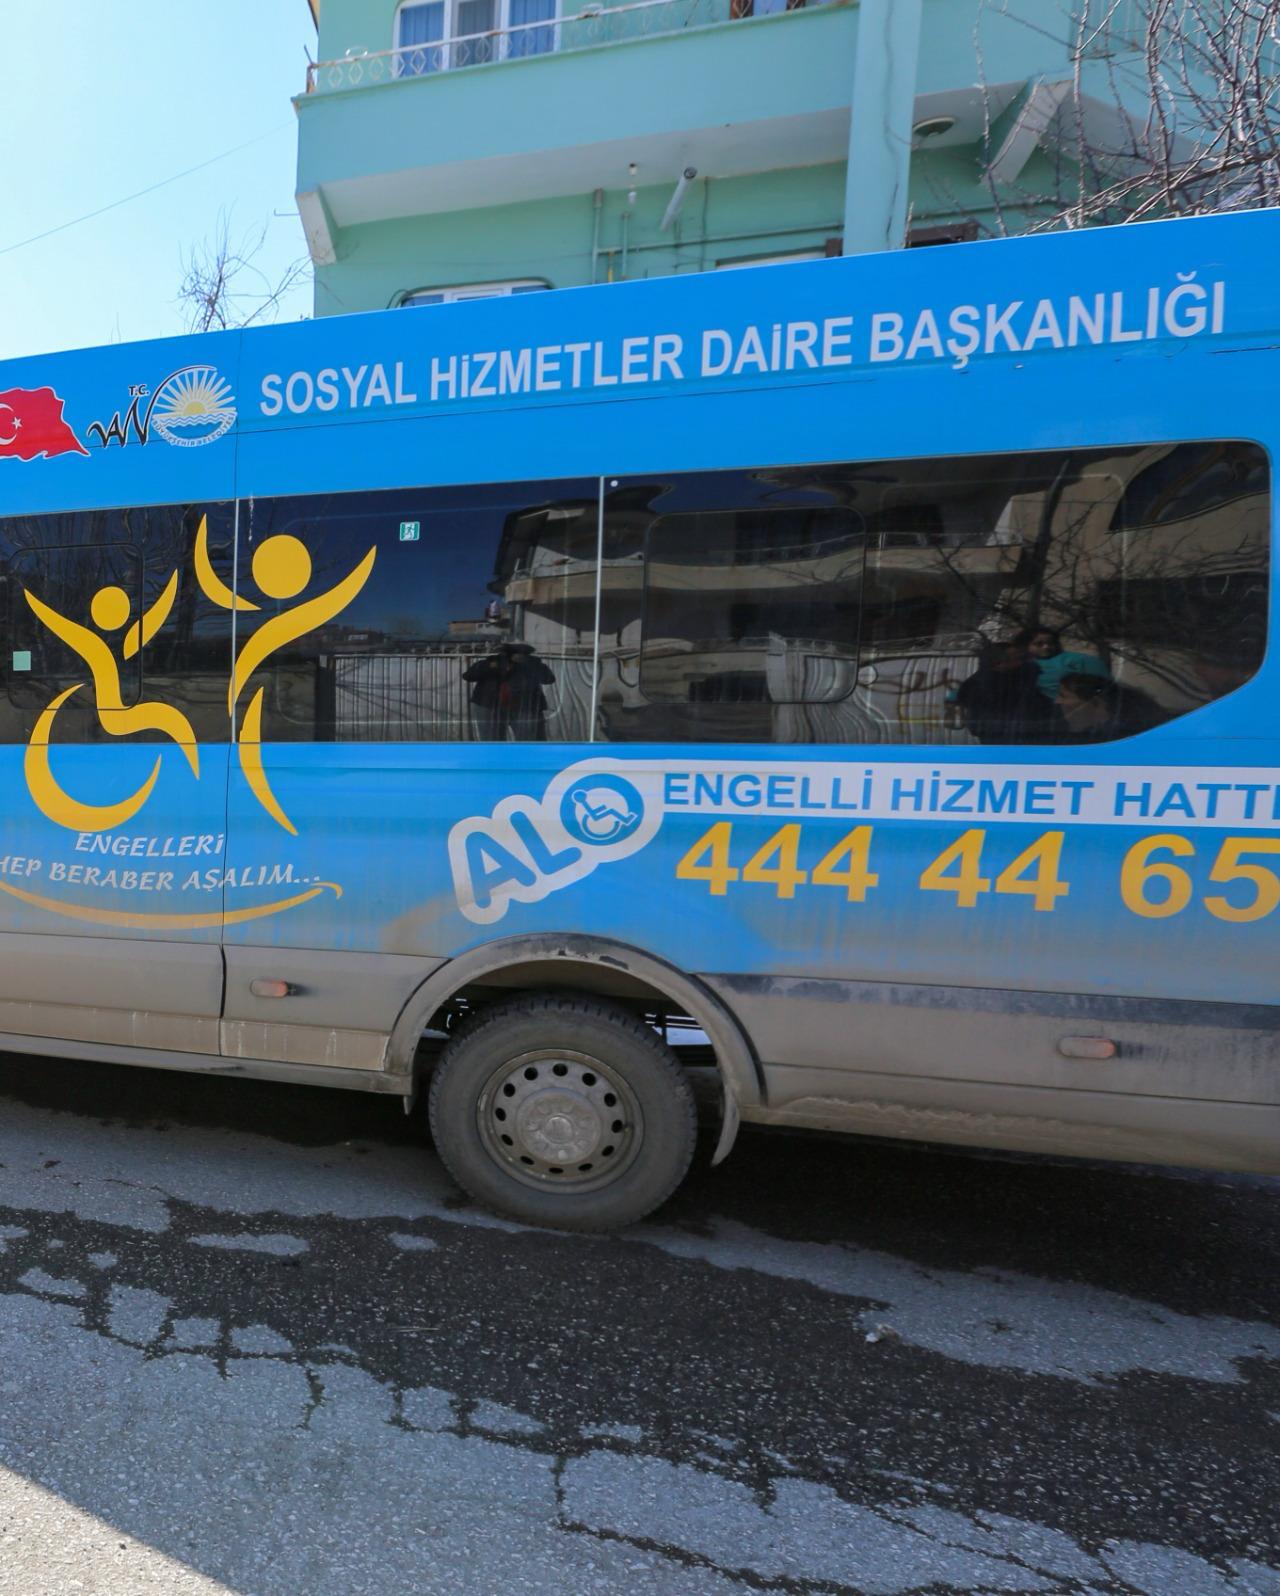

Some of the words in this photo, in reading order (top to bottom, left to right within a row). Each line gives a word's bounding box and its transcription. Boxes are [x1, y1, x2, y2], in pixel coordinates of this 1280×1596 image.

[260, 361, 417, 416] SOSYAL
[869, 271, 1225, 370] BAŞKANLIĞI
[128, 384, 150, 396] T.C.
[663, 768, 873, 810] ENGELLİ
[891, 770, 1095, 816] HİZMET
[48, 862, 174, 891] BERABER
[676, 821, 879, 902] 444
[919, 829, 1069, 911] 44
[1120, 833, 1280, 923] 65
